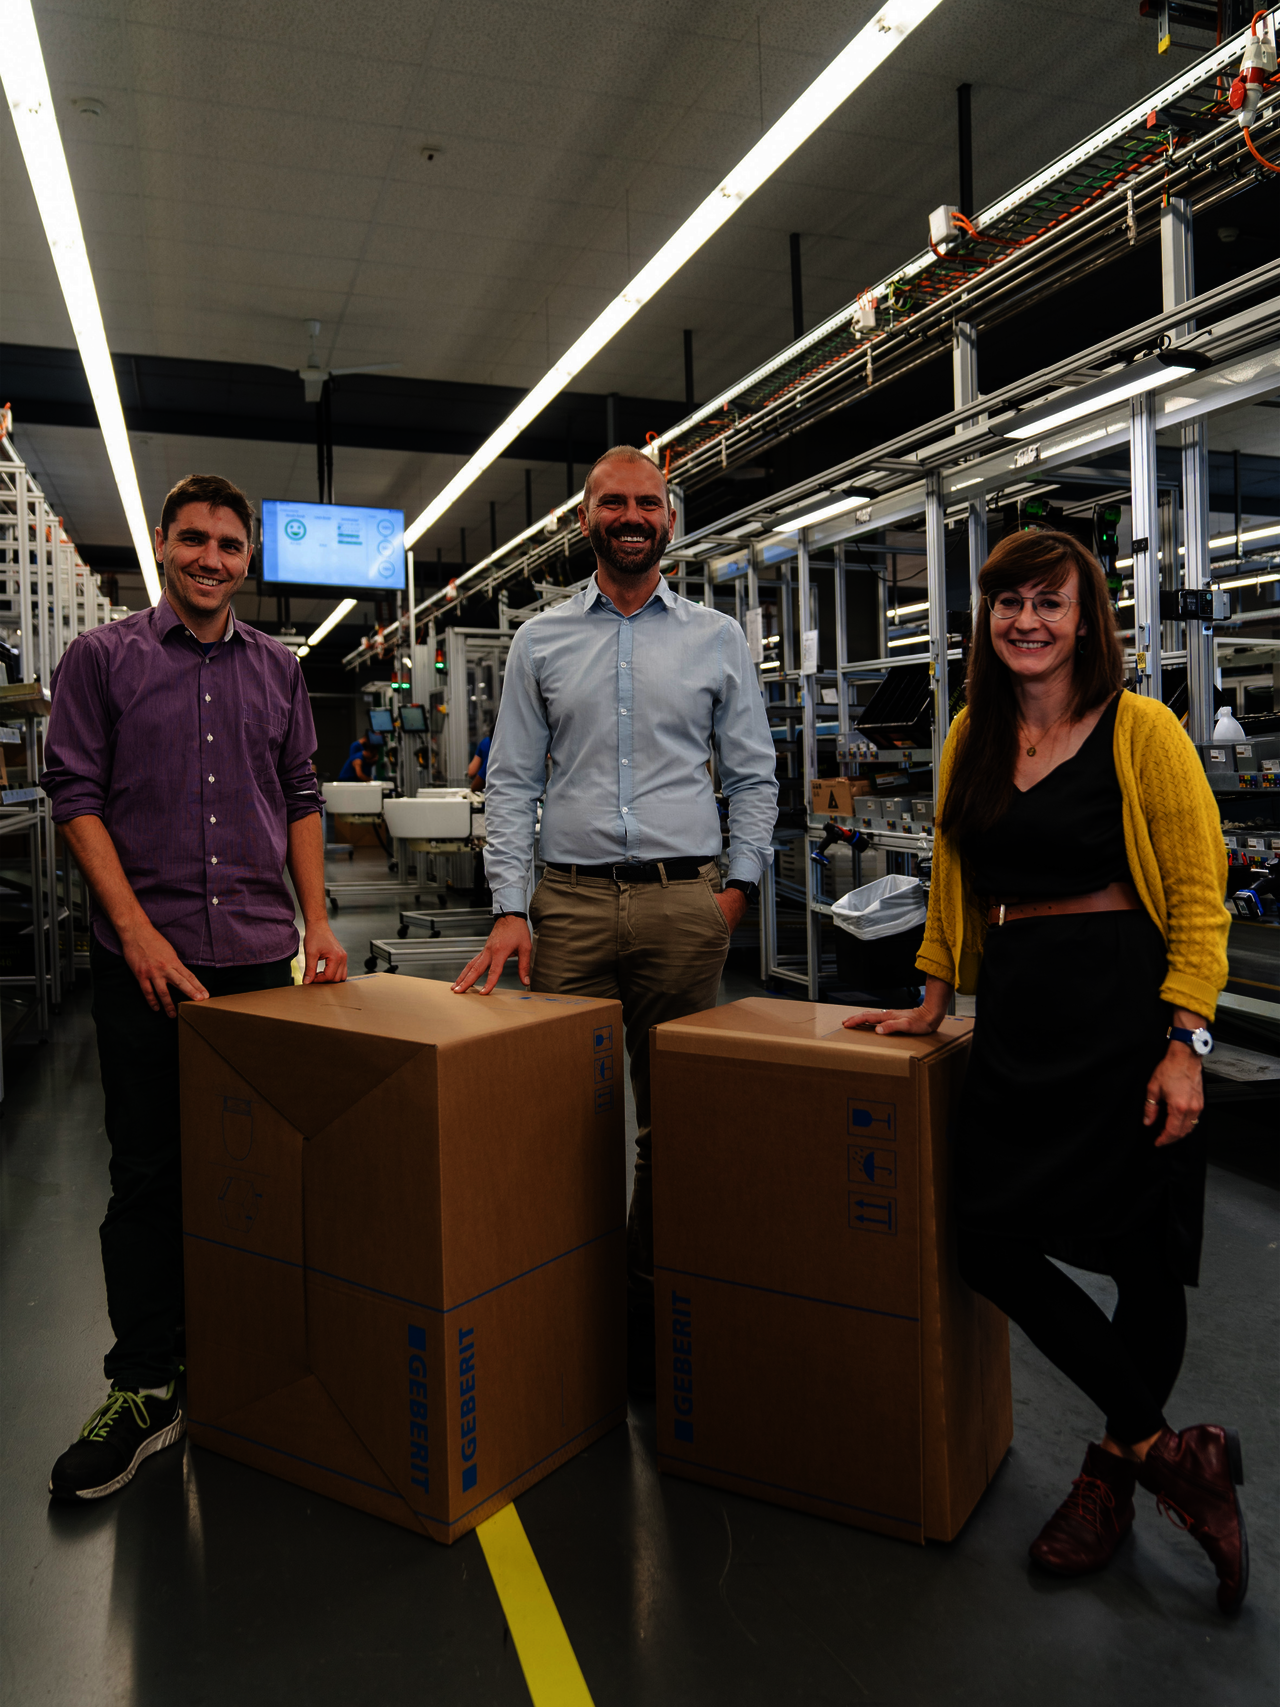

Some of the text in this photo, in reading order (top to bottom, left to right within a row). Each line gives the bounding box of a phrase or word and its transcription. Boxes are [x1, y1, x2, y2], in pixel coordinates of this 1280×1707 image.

[458, 1327, 477, 1463] GEBERIT
[671, 1290, 693, 1416] GEBERIT
[408, 1354, 429, 1495] GEBERIT
